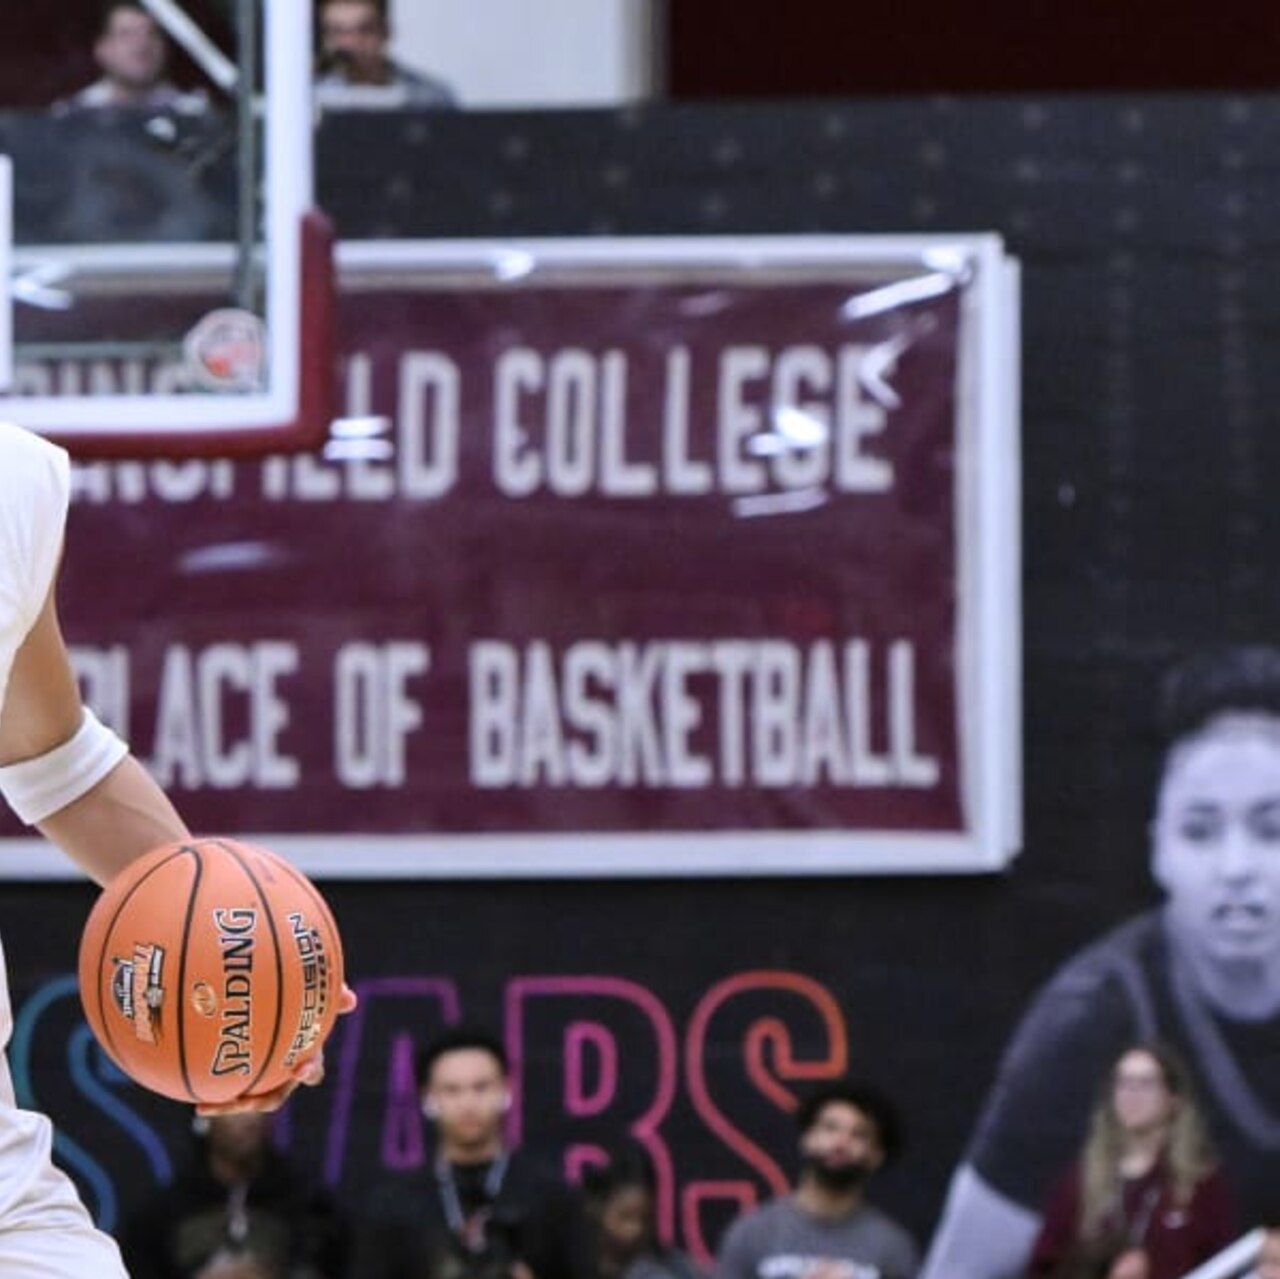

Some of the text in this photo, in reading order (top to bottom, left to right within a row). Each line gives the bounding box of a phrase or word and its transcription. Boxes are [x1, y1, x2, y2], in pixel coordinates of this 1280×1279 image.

[494, 343, 896, 498] COLLEGE
[335, 640, 432, 792] OF
[467, 638, 942, 792] BASKETBALL
[211, 907, 258, 1077] SPALDING
